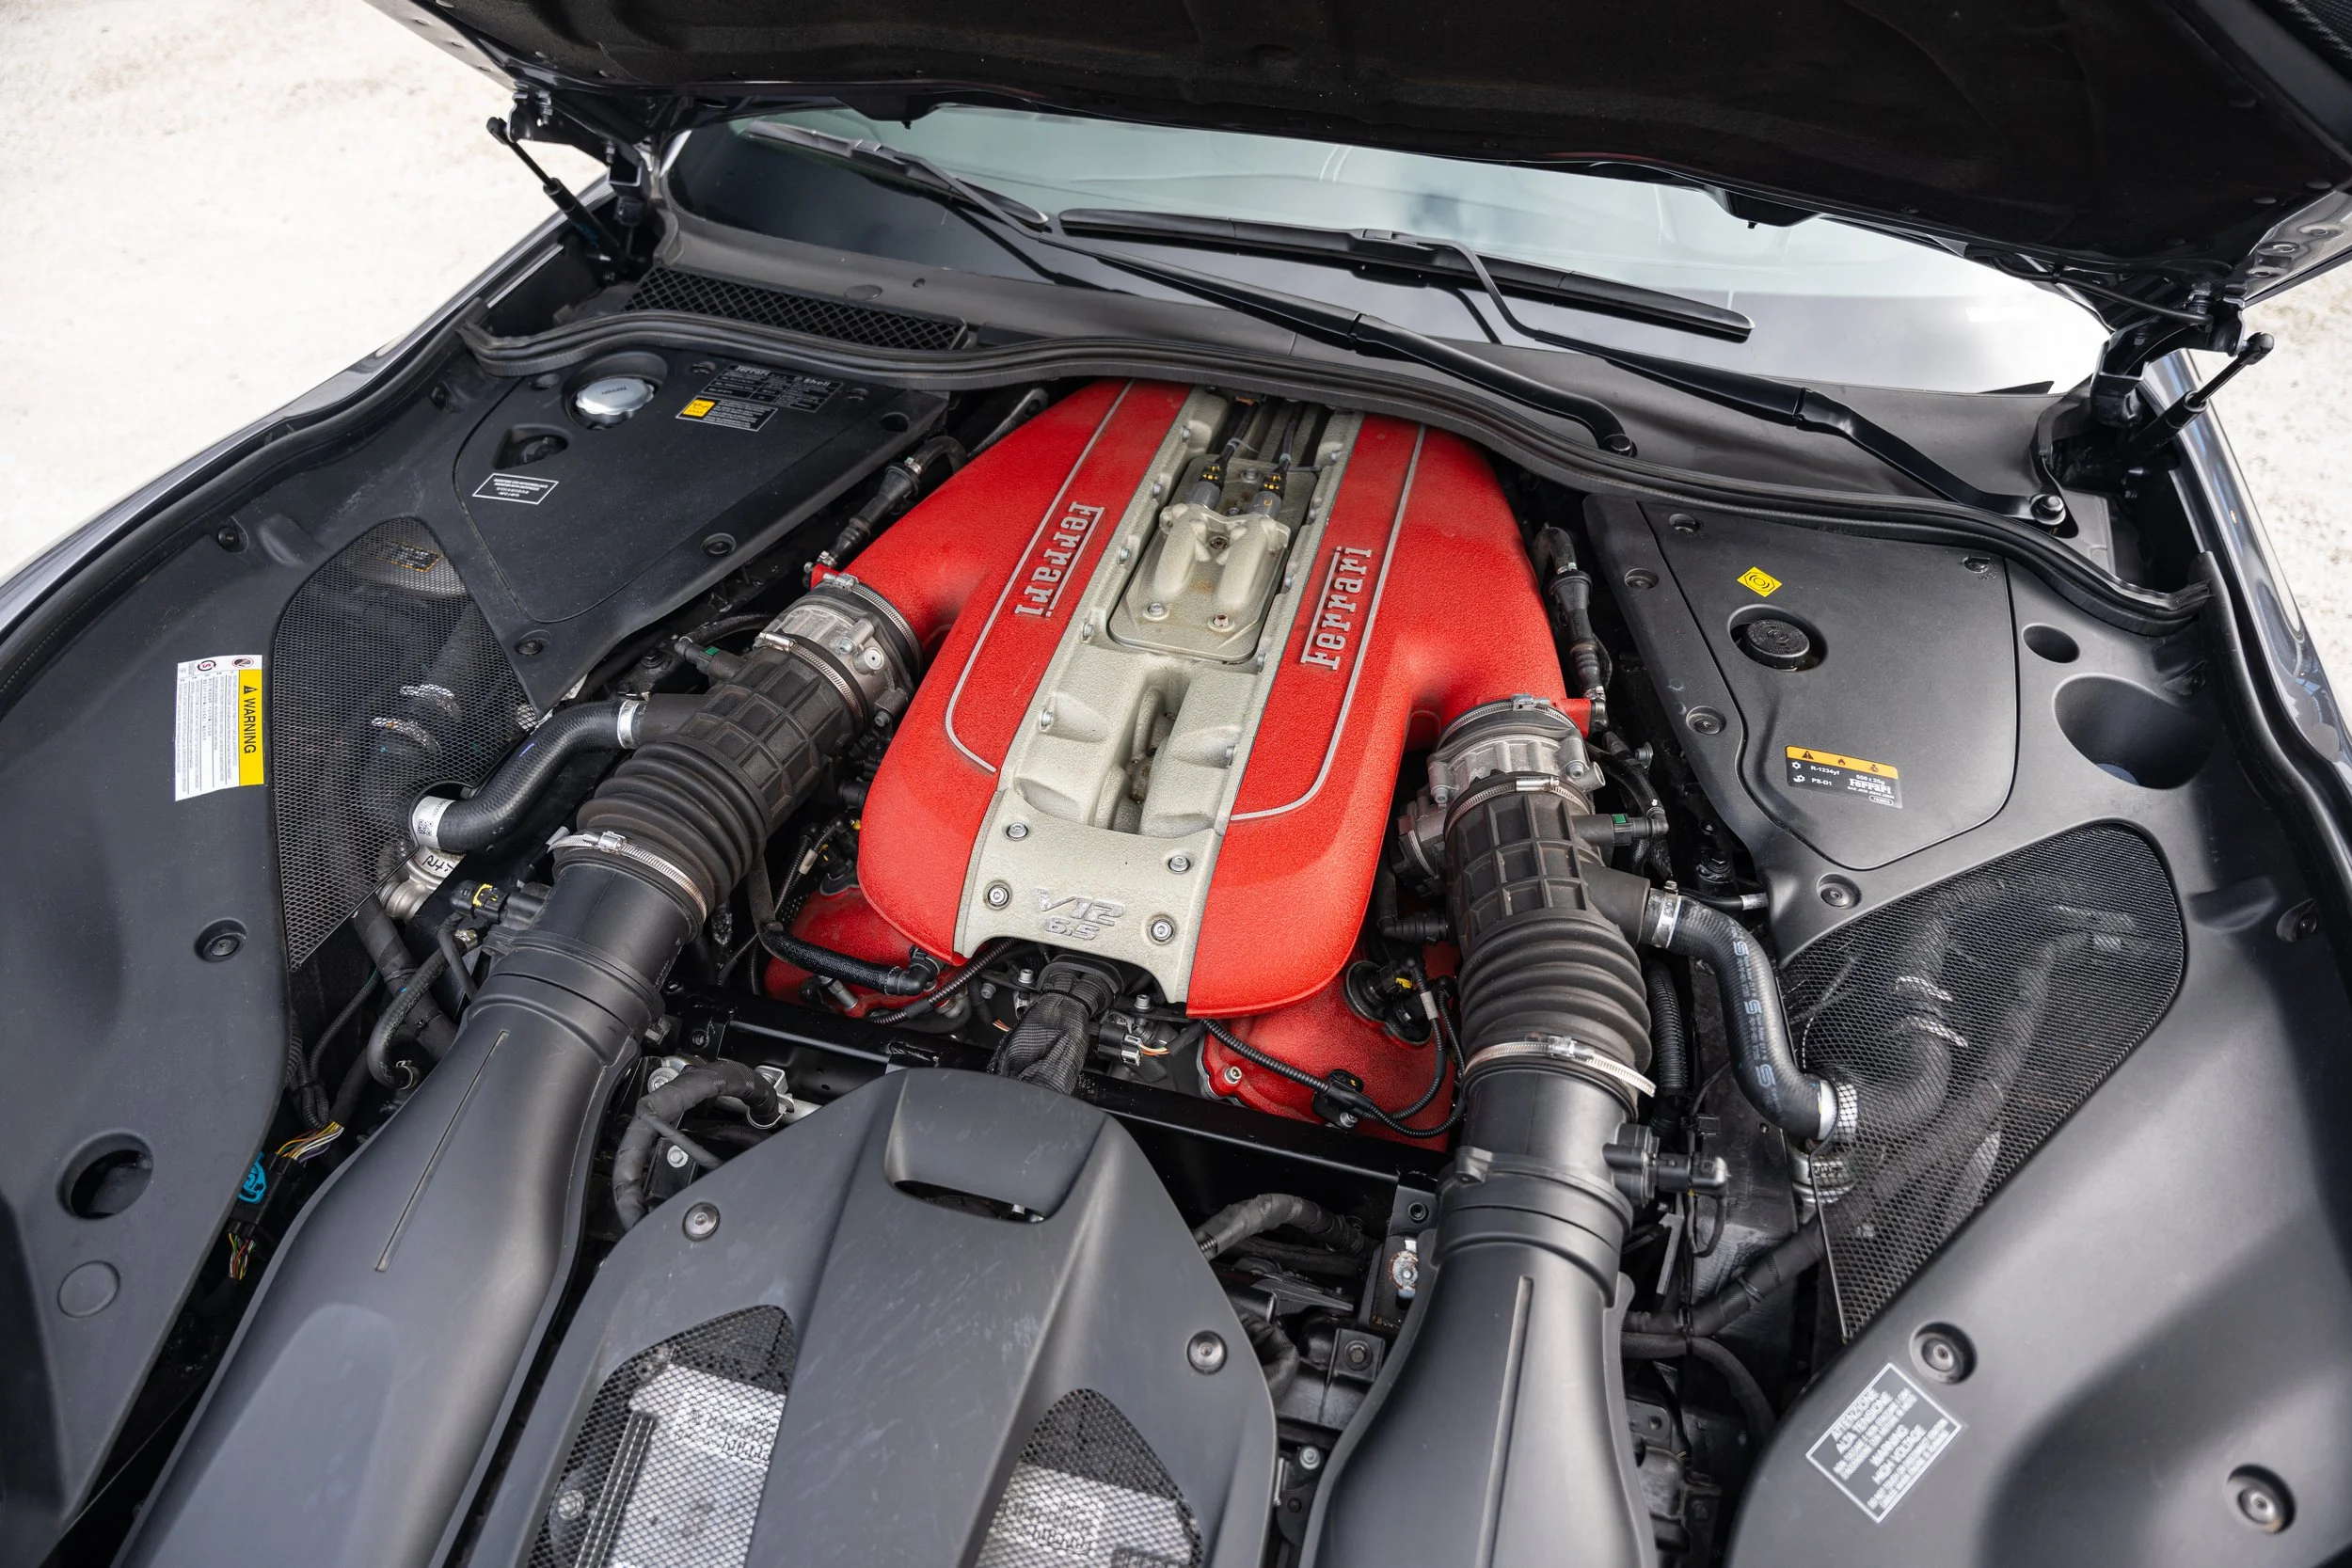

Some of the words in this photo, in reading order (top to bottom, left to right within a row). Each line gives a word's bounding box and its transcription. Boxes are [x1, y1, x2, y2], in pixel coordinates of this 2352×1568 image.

[735, 365, 771, 376] Ferrari
[803, 378, 831, 387] Shell
[1013, 501, 1104, 617] Ferrari
[1299, 546, 1373, 671] Ferrari
[244, 697, 257, 754] WARNING
[1810, 765, 1840, 776] R-1234yf
[1849, 778, 1891, 794] Ferrari
[1035, 888, 1124, 927] V12
[1043, 917, 1101, 941] 6.5
[1830, 1387, 1880, 1441] ATTENZIONE
[1835, 1430, 1858, 1454] ALTA
[1852, 1390, 1893, 1434] TENSIONE
[1870, 1423, 1909, 1466] WARNING
[1871, 1458, 1896, 1484] HIGH
[1890, 1423, 1927, 1463] VOLTAGE
